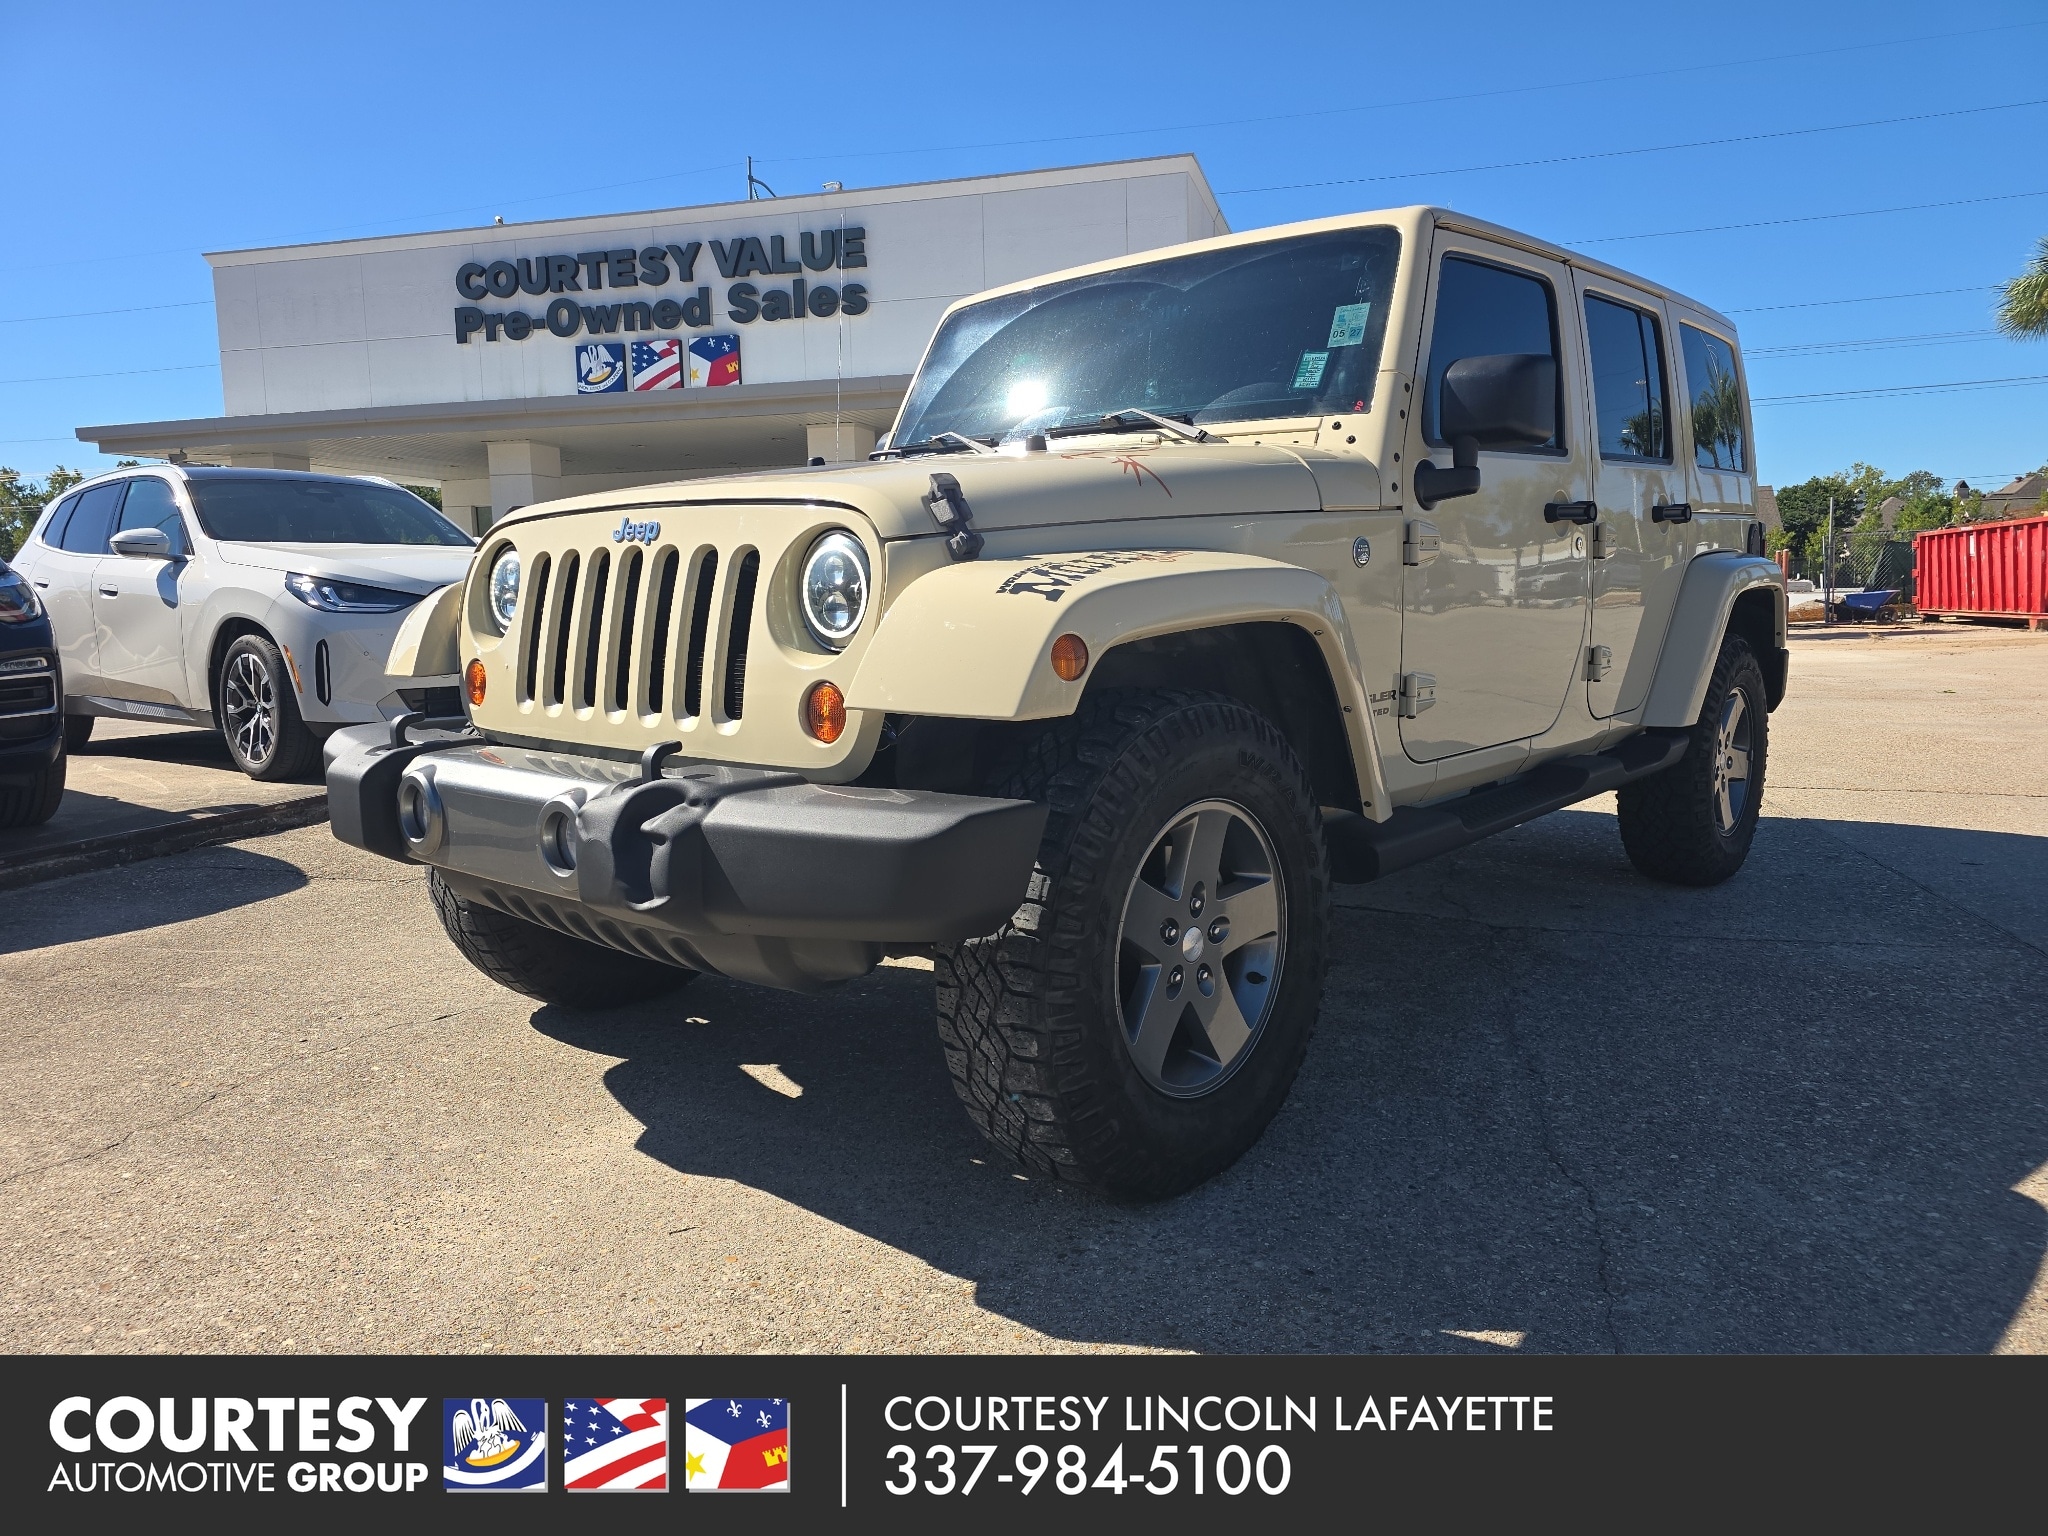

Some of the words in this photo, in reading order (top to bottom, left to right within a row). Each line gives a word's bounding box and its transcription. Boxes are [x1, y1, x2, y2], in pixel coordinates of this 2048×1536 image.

[456, 241, 702, 300] COURTESY
[708, 226, 868, 279] VALUE
[454, 287, 713, 344] Pre-Owned
[727, 278, 869, 324] Sales
[1332, 329, 1346, 339] 05
[1349, 328, 1362, 337] 27
[612, 517, 661, 546] Jeep
